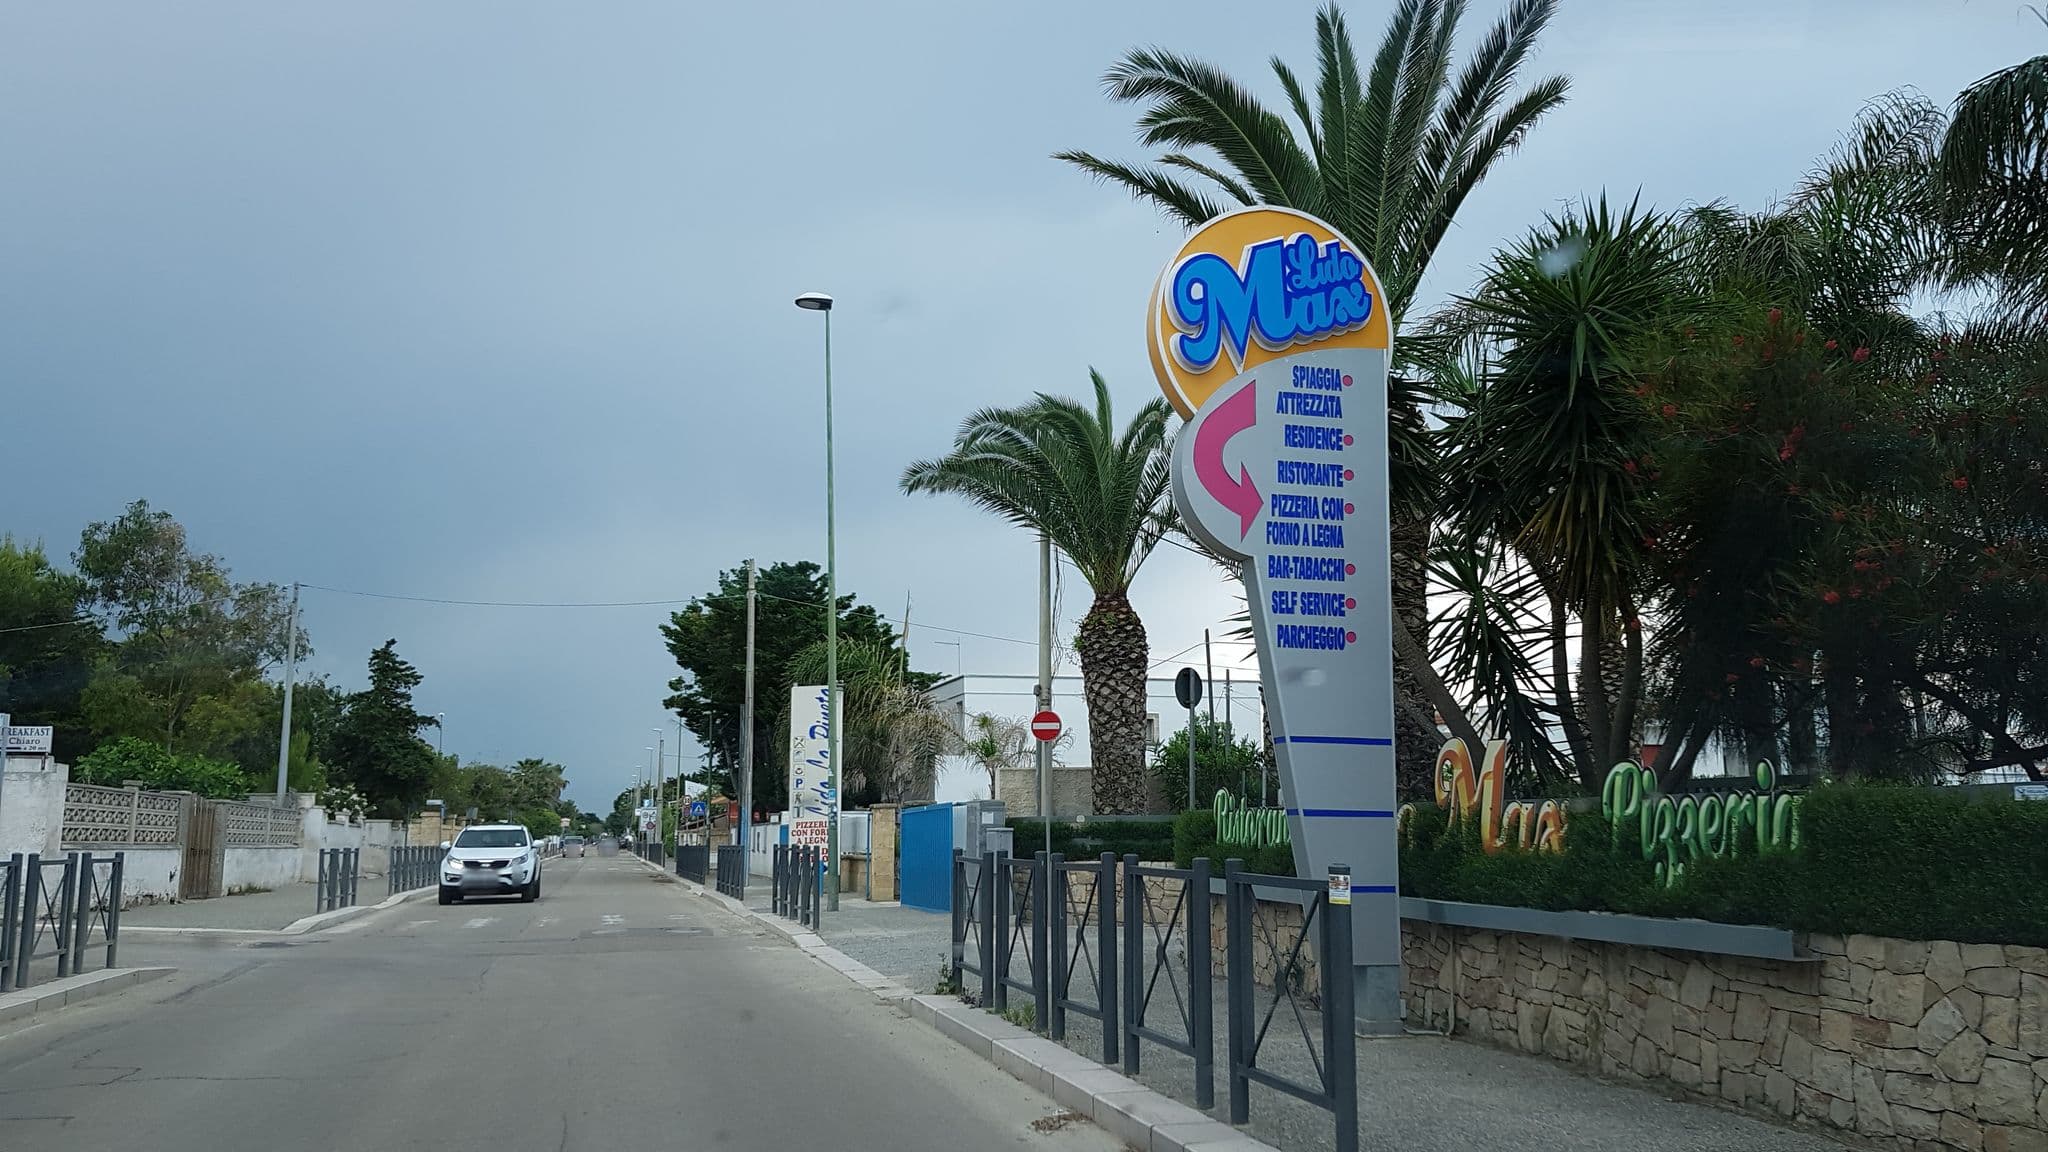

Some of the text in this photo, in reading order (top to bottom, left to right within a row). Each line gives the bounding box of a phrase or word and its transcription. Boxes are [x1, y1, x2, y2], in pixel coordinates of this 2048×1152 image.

[1286, 233, 1363, 290] Lido
[1172, 239, 1373, 367] Max
[1292, 365, 1343, 392] SPIAGGIA
[1276, 391, 1343, 419] ATTREZZATA
[1284, 424, 1344, 452] RESIDENCE
[1277, 460, 1344, 488] RISTORANTE
[1271, 494, 1345, 521] PIZZERIA CON
[1266, 521, 1345, 549] FORNO A LEGNA
[1267, 554, 1345, 582] BAR-TABACCHI
[1271, 590, 1346, 617] SELF SERVICE
[1277, 624, 1346, 651] PARCHEGGIO
[9, 737, 41, 745] Chiaro
[791, 829, 808, 837] CON
[796, 821, 828, 829] PIZZERI
[797, 836, 829, 845] A LEGN
